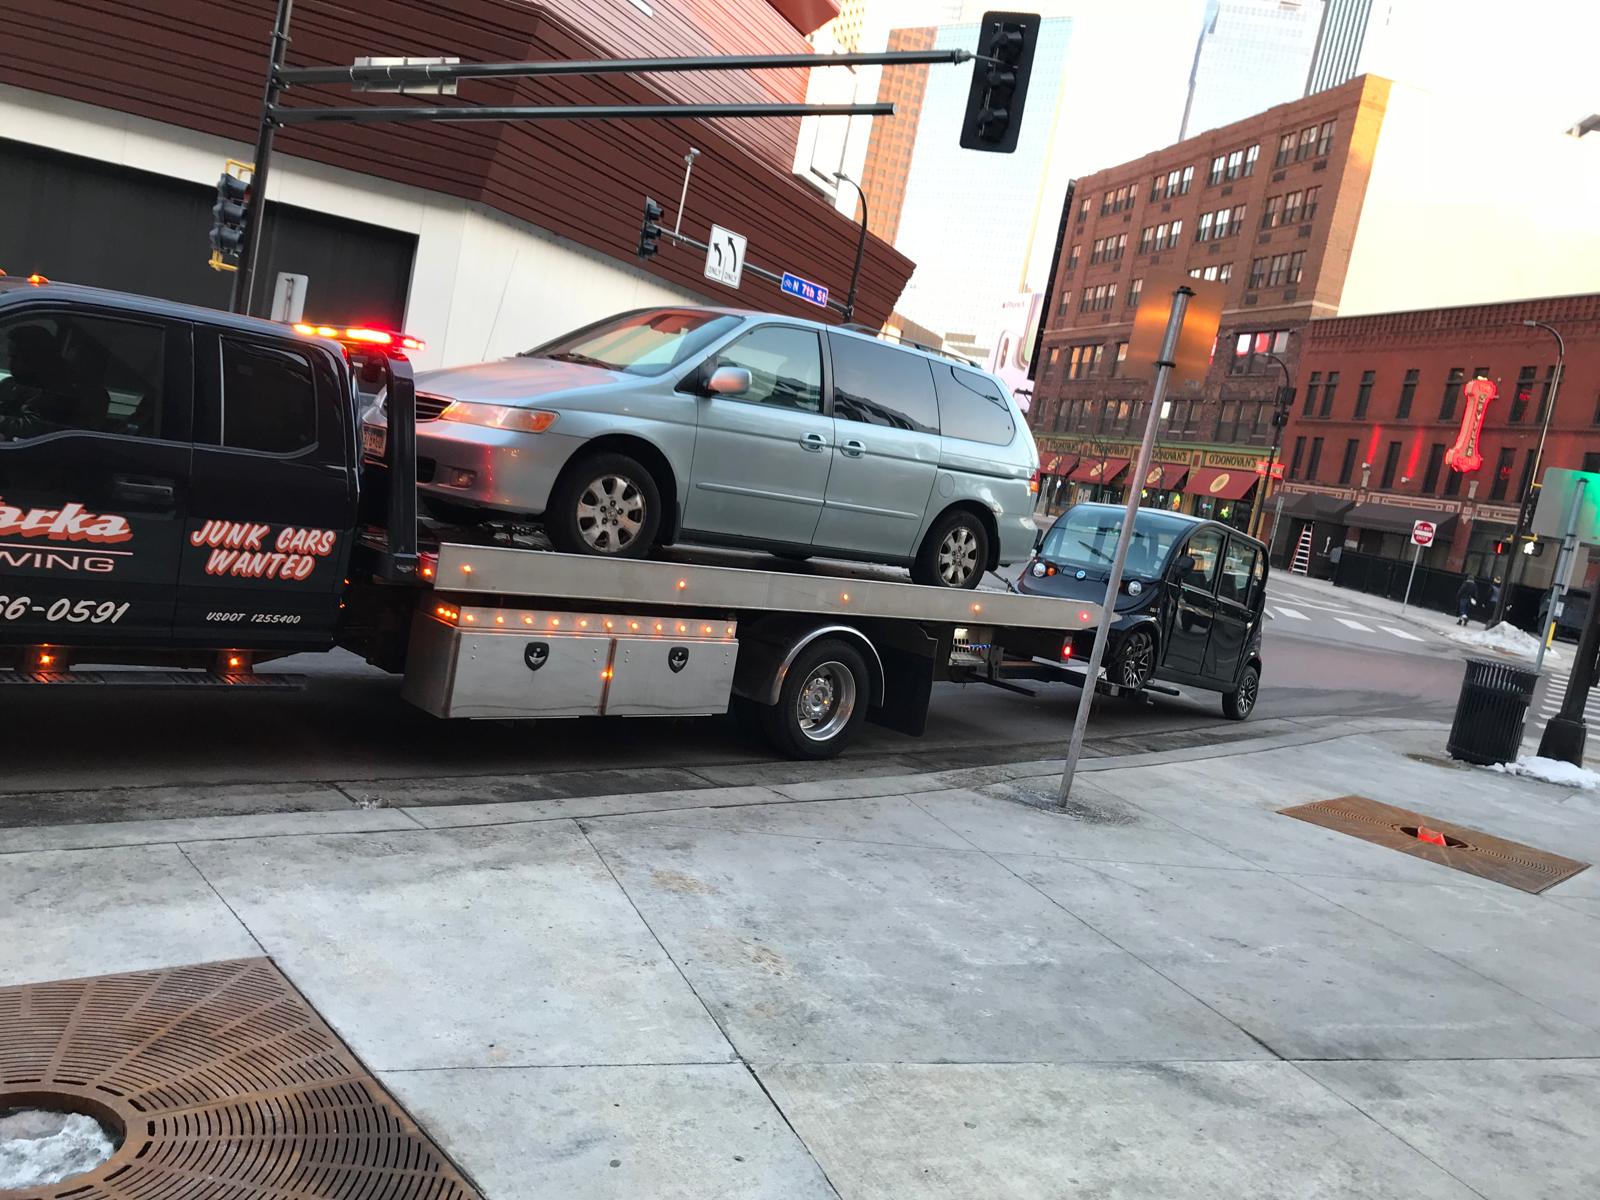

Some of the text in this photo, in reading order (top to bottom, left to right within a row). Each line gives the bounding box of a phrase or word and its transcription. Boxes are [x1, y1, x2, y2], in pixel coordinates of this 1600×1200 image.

[724, 271, 738, 282] ONLY
[793, 280, 826, 303] N 7th St
[1209, 454, 1257, 468] O'DONOVAN'S
[191, 520, 336, 556] JUNK CARS
[205, 549, 316, 580] WANTED
[206, 612, 301, 624] USDOT 1255400
